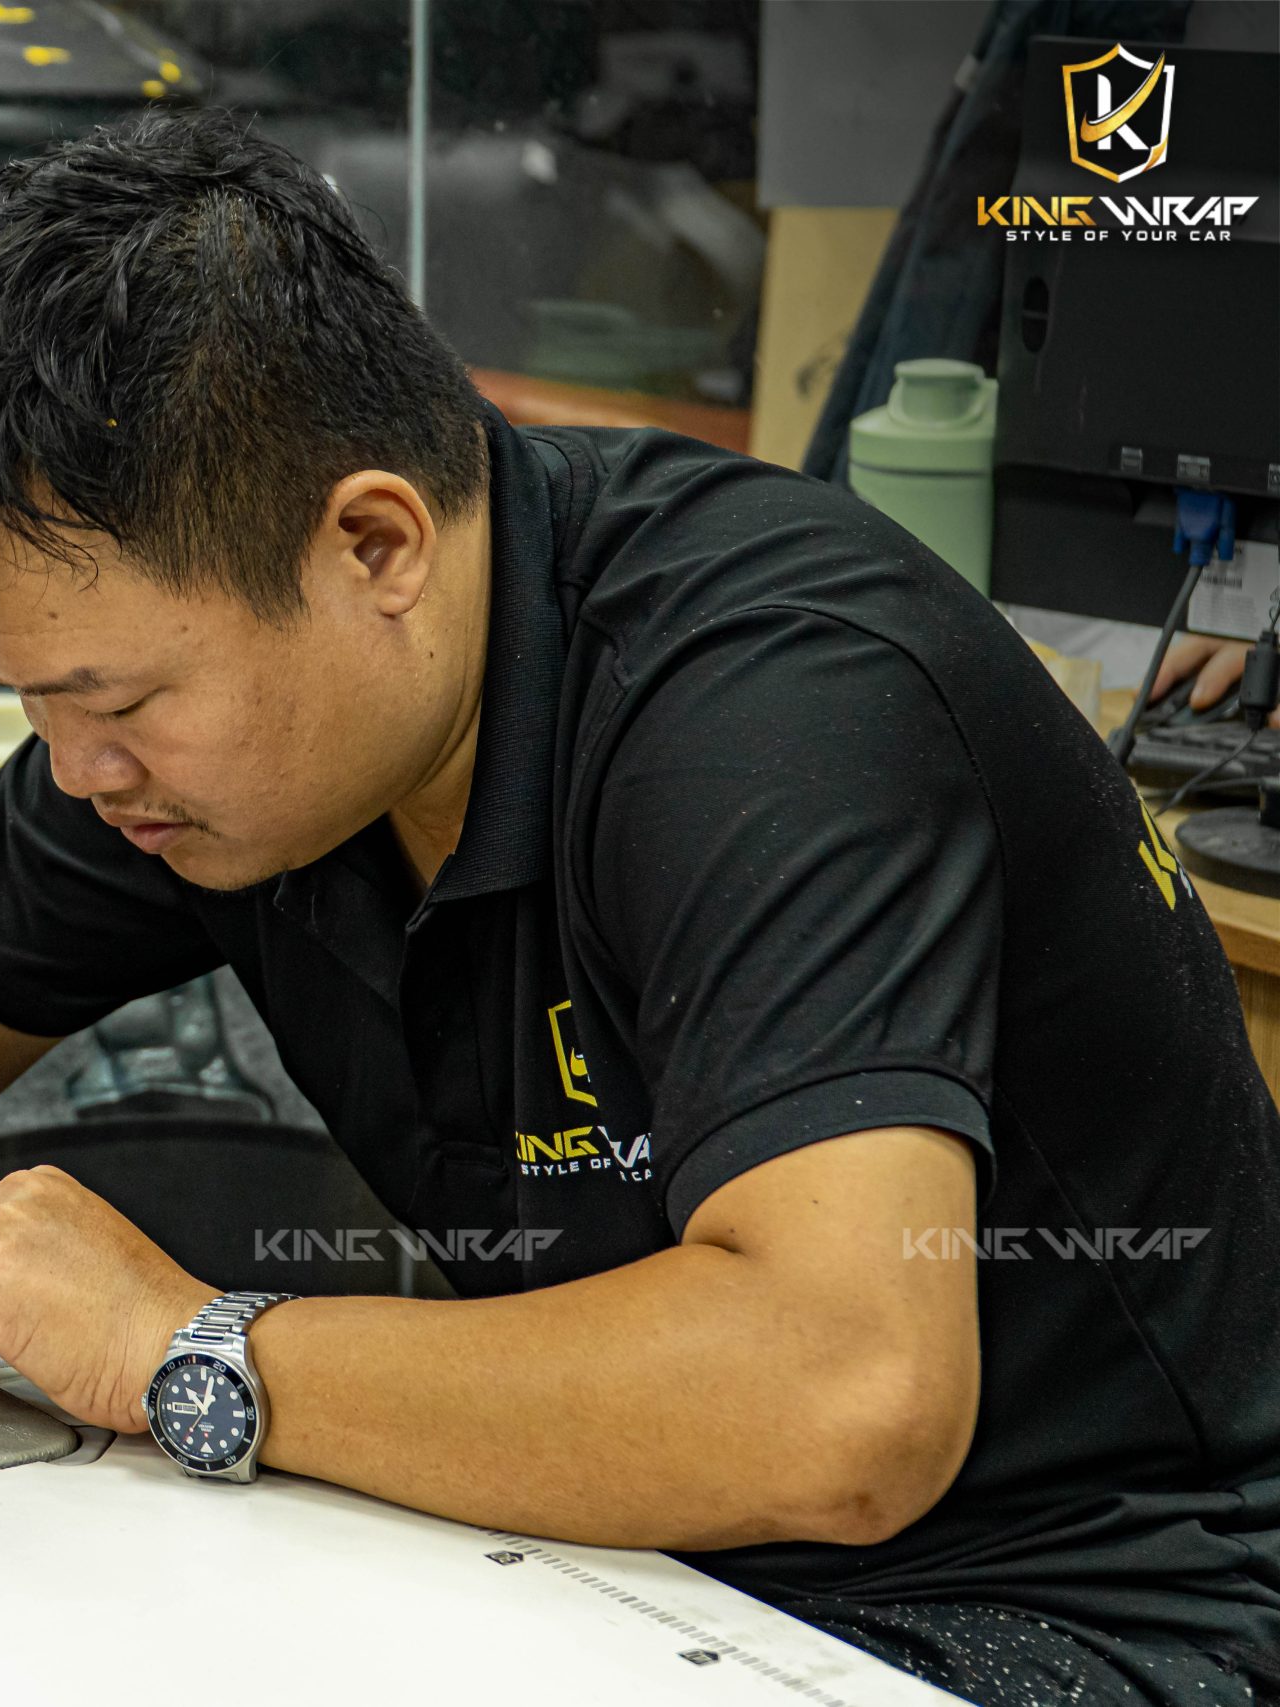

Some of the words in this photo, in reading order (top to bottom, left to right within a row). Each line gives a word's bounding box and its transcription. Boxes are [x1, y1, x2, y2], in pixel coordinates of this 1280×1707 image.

[516, 1126, 600, 1162] ING
[520, 1161, 580, 1177] STYLE
[590, 1158, 611, 1170] OF
[212, 1360, 227, 1373] 20
[246, 1406, 255, 1420] 30
